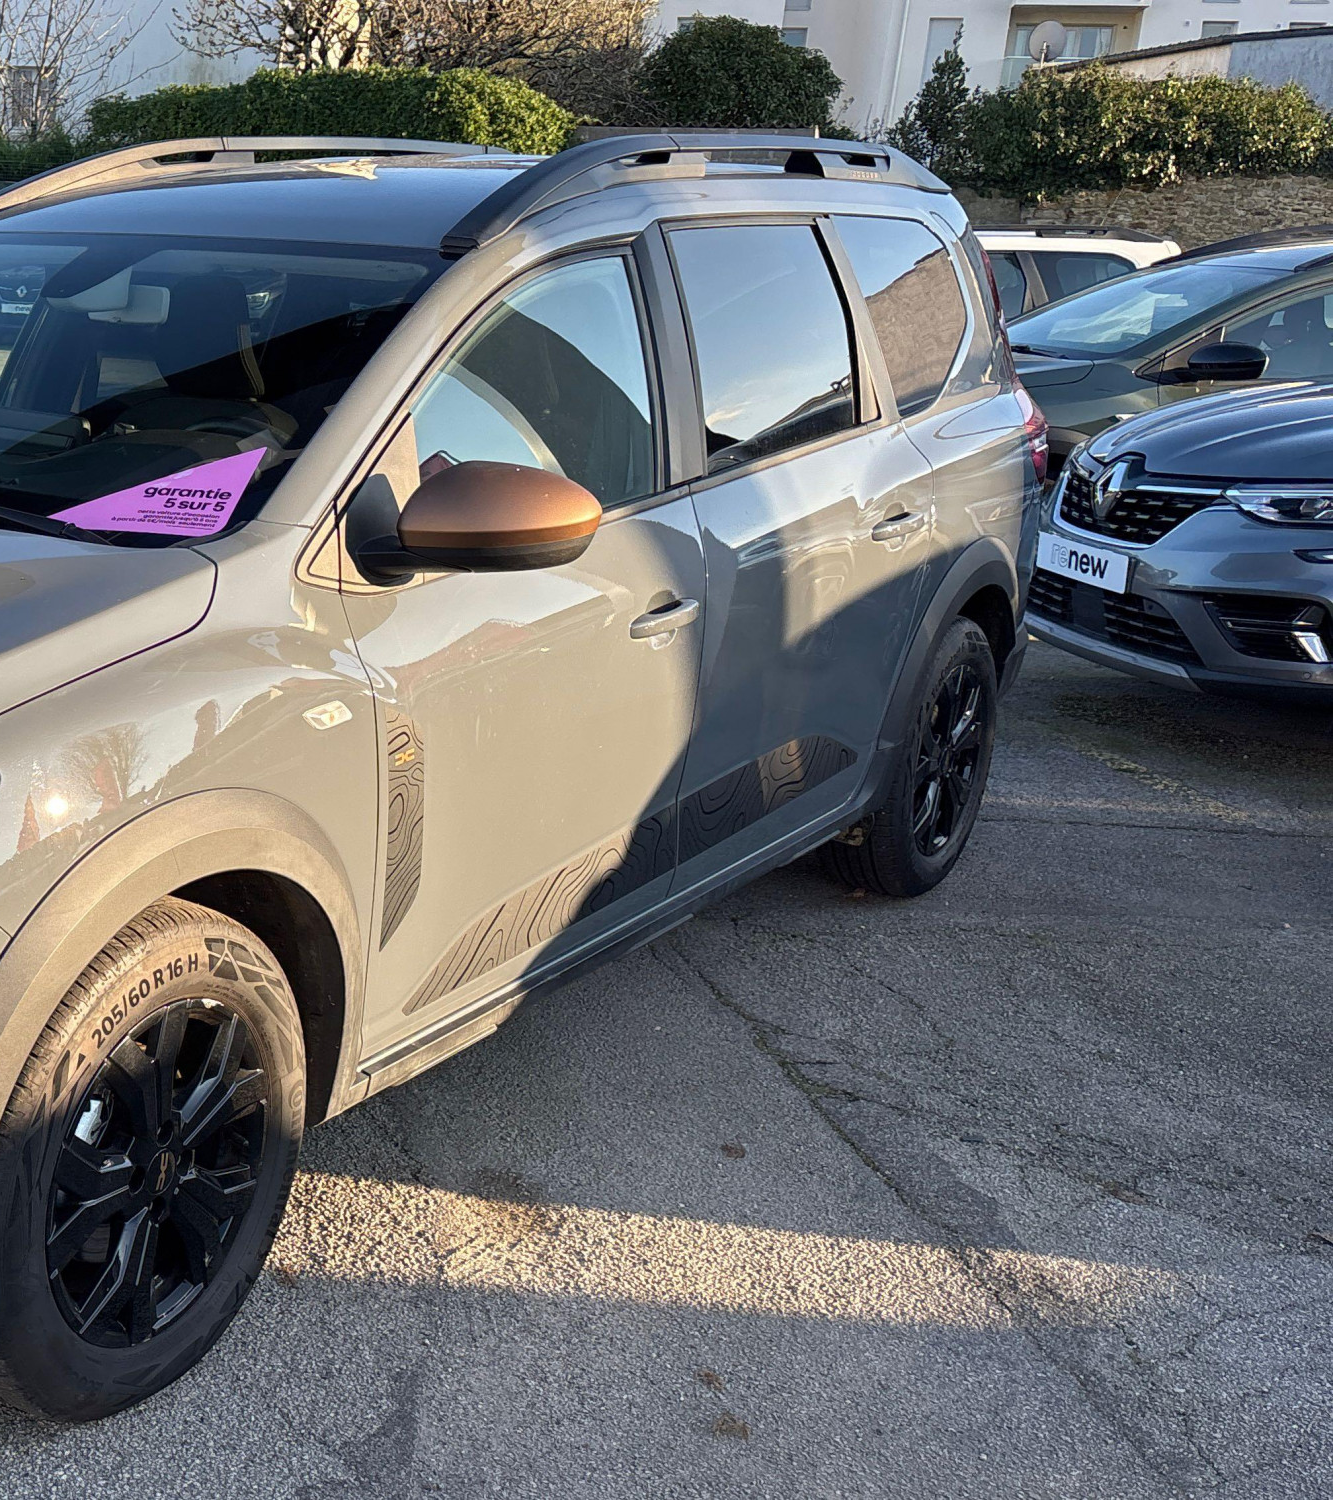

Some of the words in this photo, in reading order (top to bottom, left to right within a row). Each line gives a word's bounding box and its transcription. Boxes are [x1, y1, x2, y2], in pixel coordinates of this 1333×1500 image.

[143, 486, 232, 500] garantie
[163, 497, 177, 509] 5
[177, 500, 213, 511] sur
[212, 501, 227, 512] 5
[1051, 543, 1109, 579] renew
[91, 978, 151, 1049] 205/60
[152, 968, 165, 989] R
[165, 957, 184, 981] 16
[187, 952, 199, 973] H
